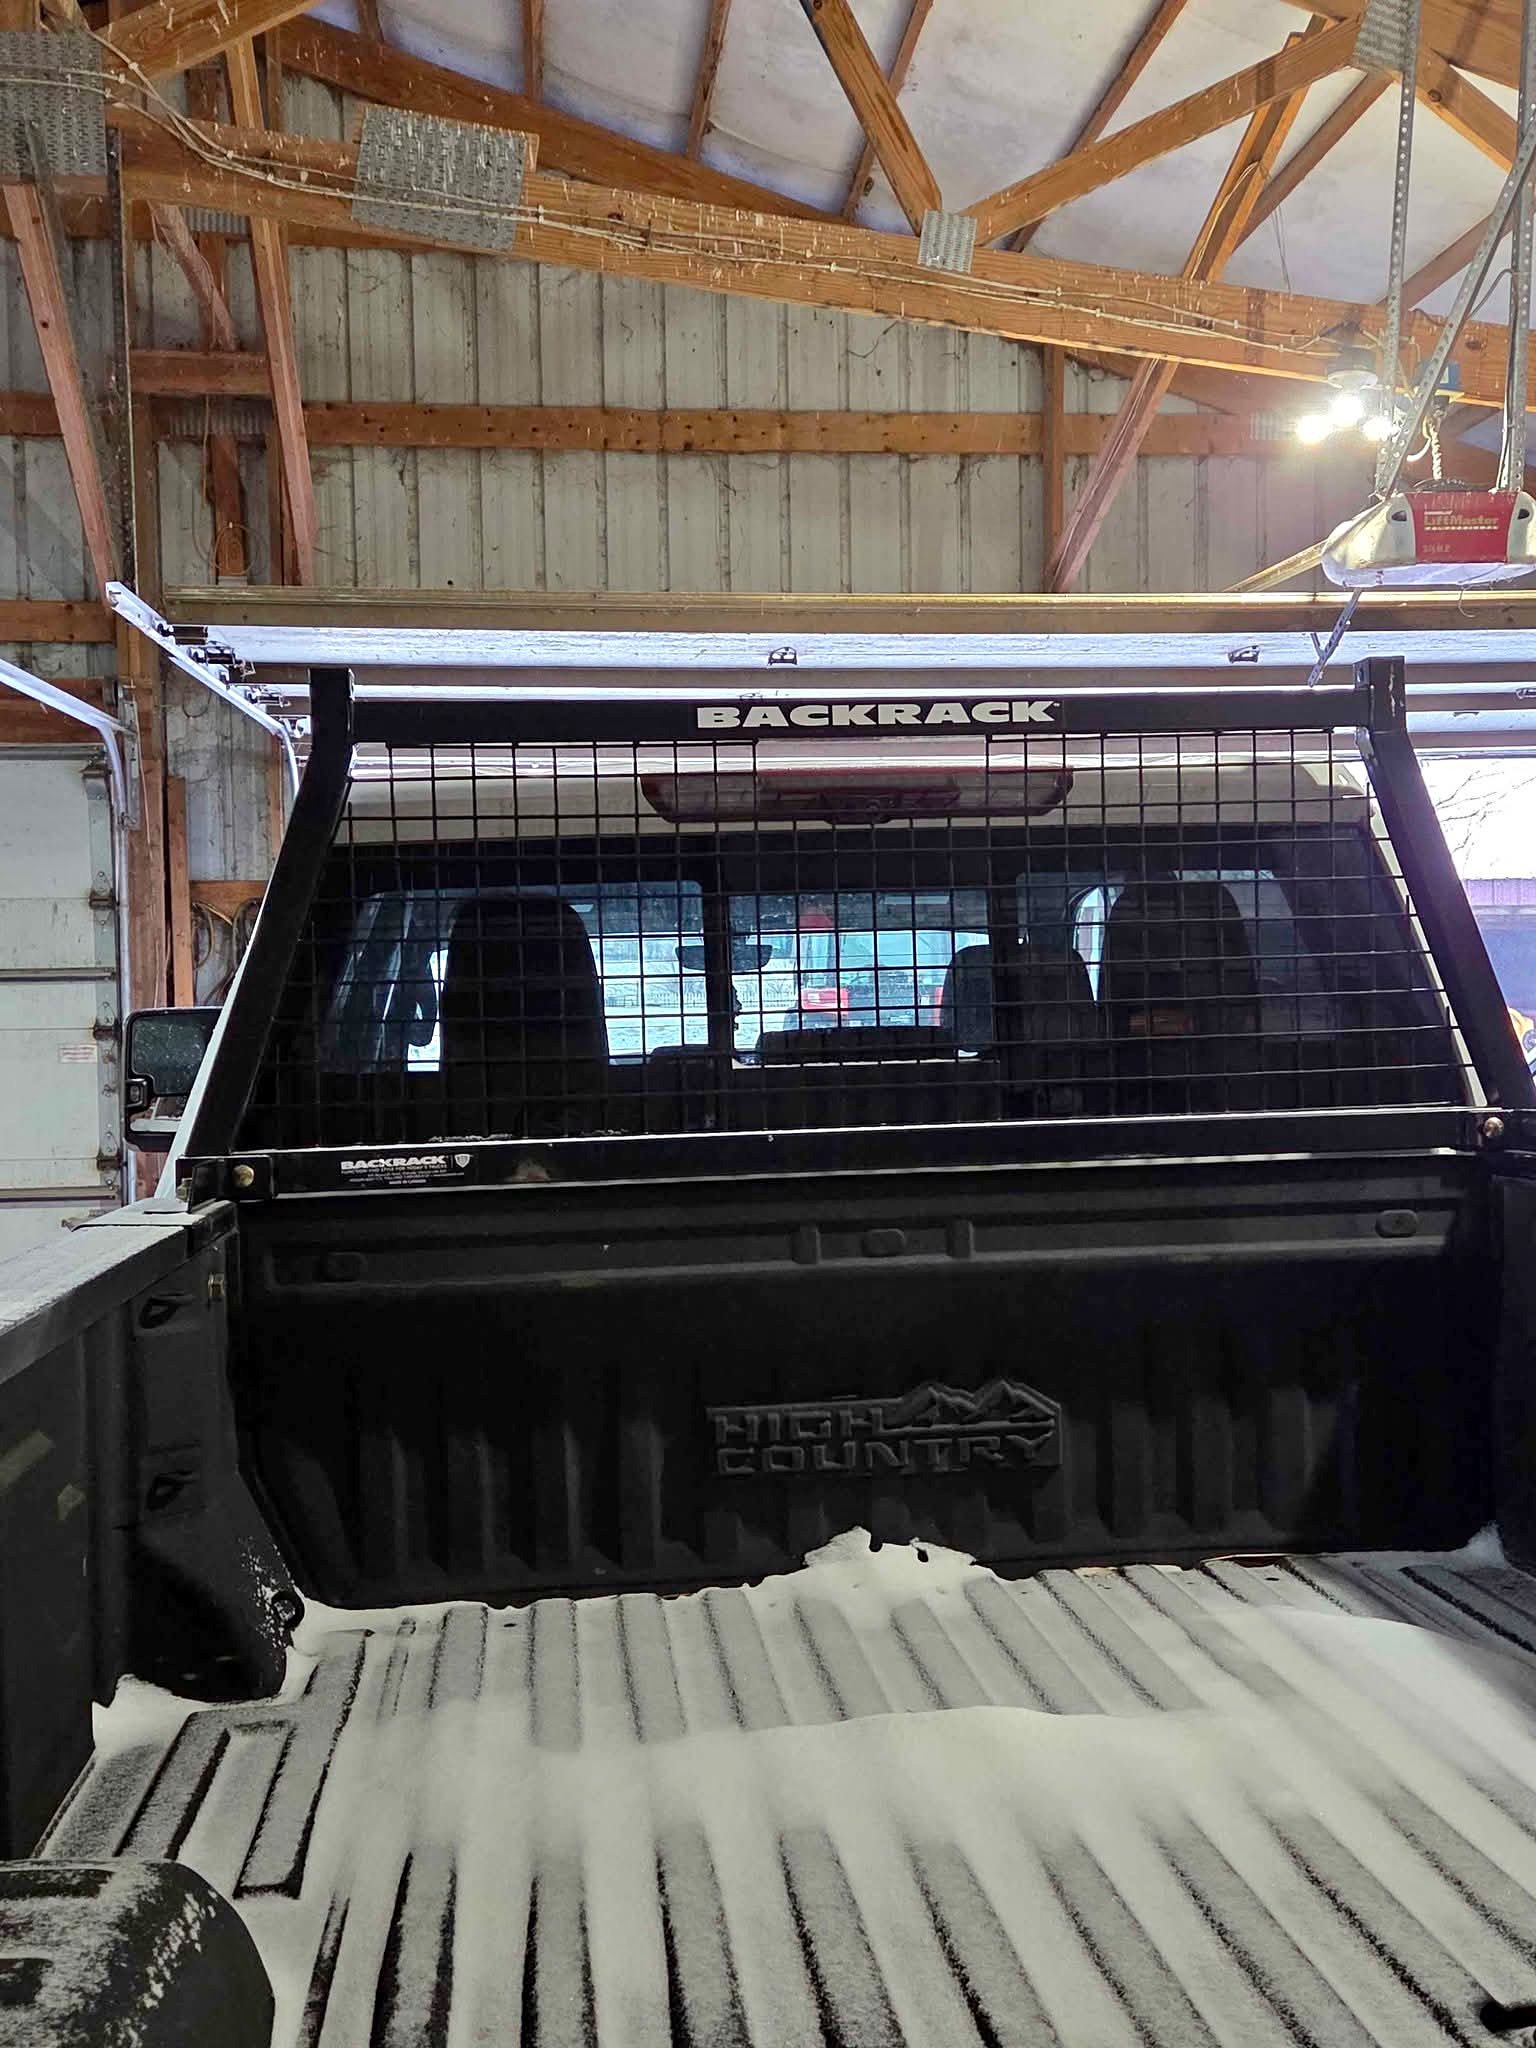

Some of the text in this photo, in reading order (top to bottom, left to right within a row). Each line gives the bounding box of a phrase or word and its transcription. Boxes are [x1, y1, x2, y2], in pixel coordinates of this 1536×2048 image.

[1424, 515, 1498, 526] LiftMaster
[697, 701, 1055, 729] BACKRACK
[341, 1155, 446, 1170] BACKRACK
[713, 1405, 886, 1445] HIGH
[716, 1434, 1056, 1473] COUNTRY
